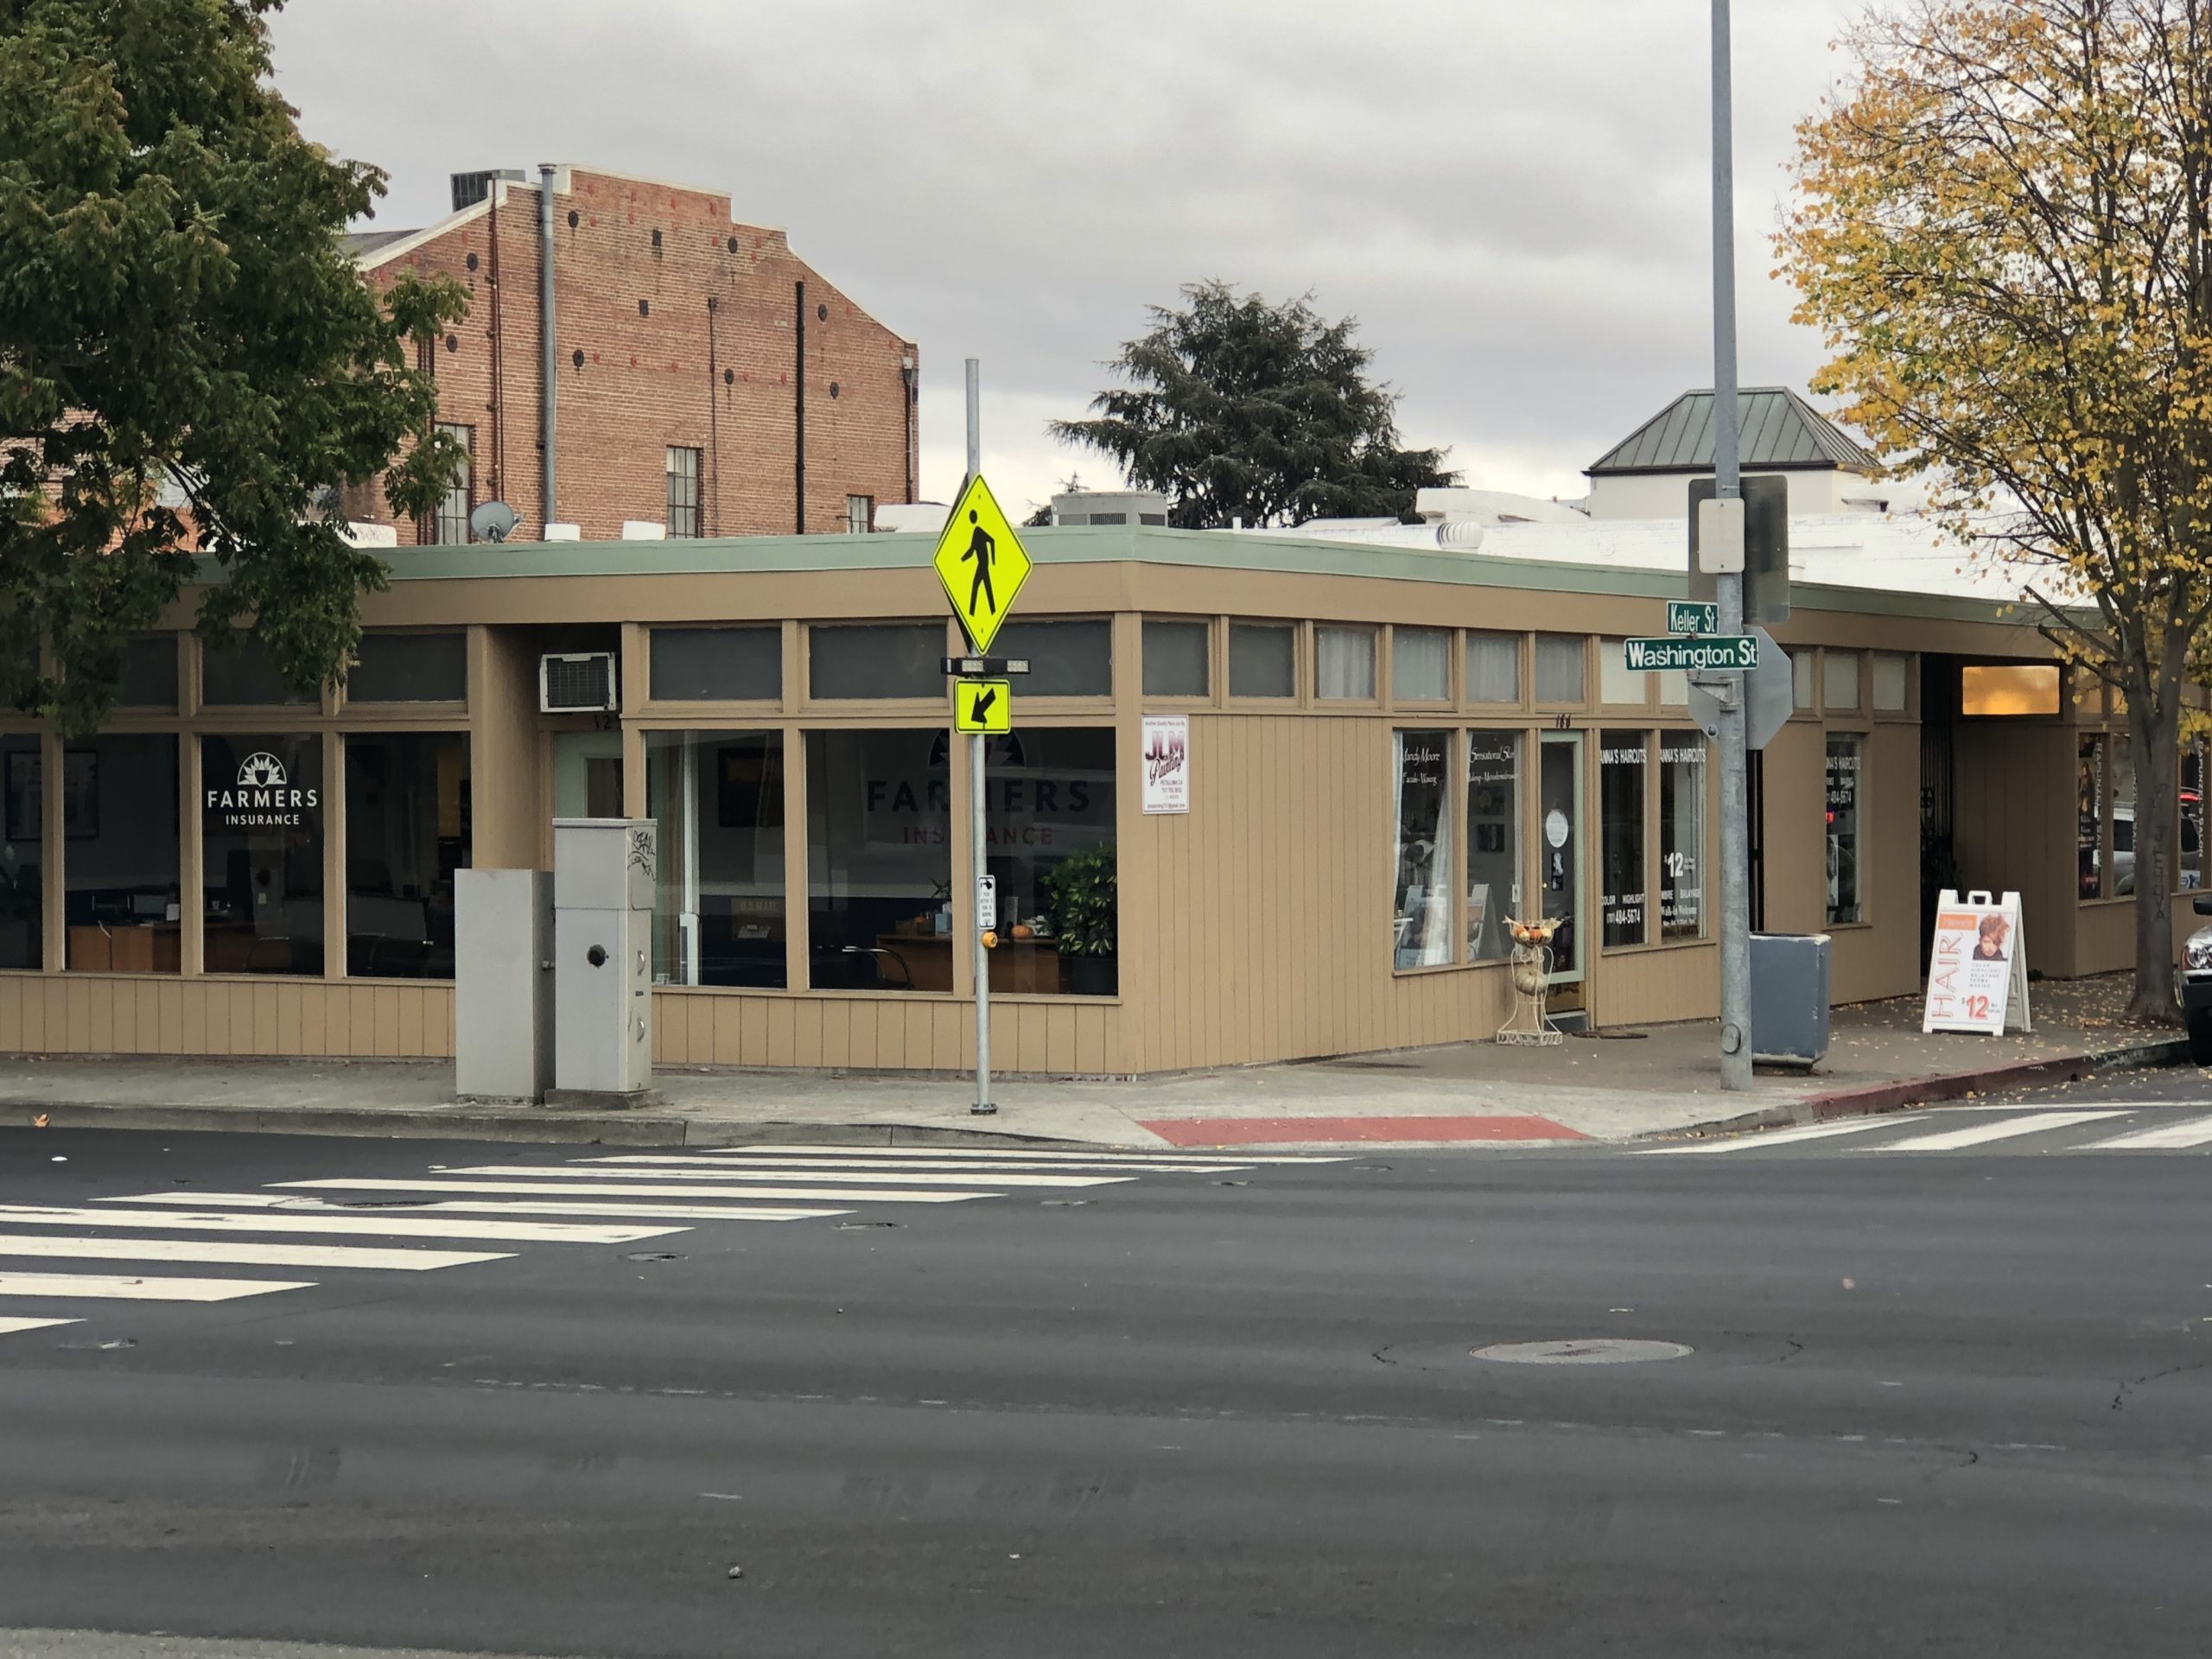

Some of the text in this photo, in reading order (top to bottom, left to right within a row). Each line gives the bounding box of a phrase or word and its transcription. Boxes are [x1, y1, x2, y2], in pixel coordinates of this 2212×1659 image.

[1670, 604, 1715, 632] Keller St
[1628, 639, 1757, 669] Washington St
[1145, 731, 1185, 760] JLM
[1421, 747, 1440, 763] Moore
[1680, 747, 1707, 763] HAIRCUTS
[1620, 748, 1647, 764] HAIRCUTS
[1149, 748, 1184, 786] Painting
[207, 789, 318, 808] FARMERS
[868, 780, 1090, 812] FARERS
[226, 814, 300, 825] INSURANCE
[904, 826, 1053, 845] INSANCE
[1615, 908, 1641, 925] 484-5674
[1931, 932, 1964, 1018] HAIR
